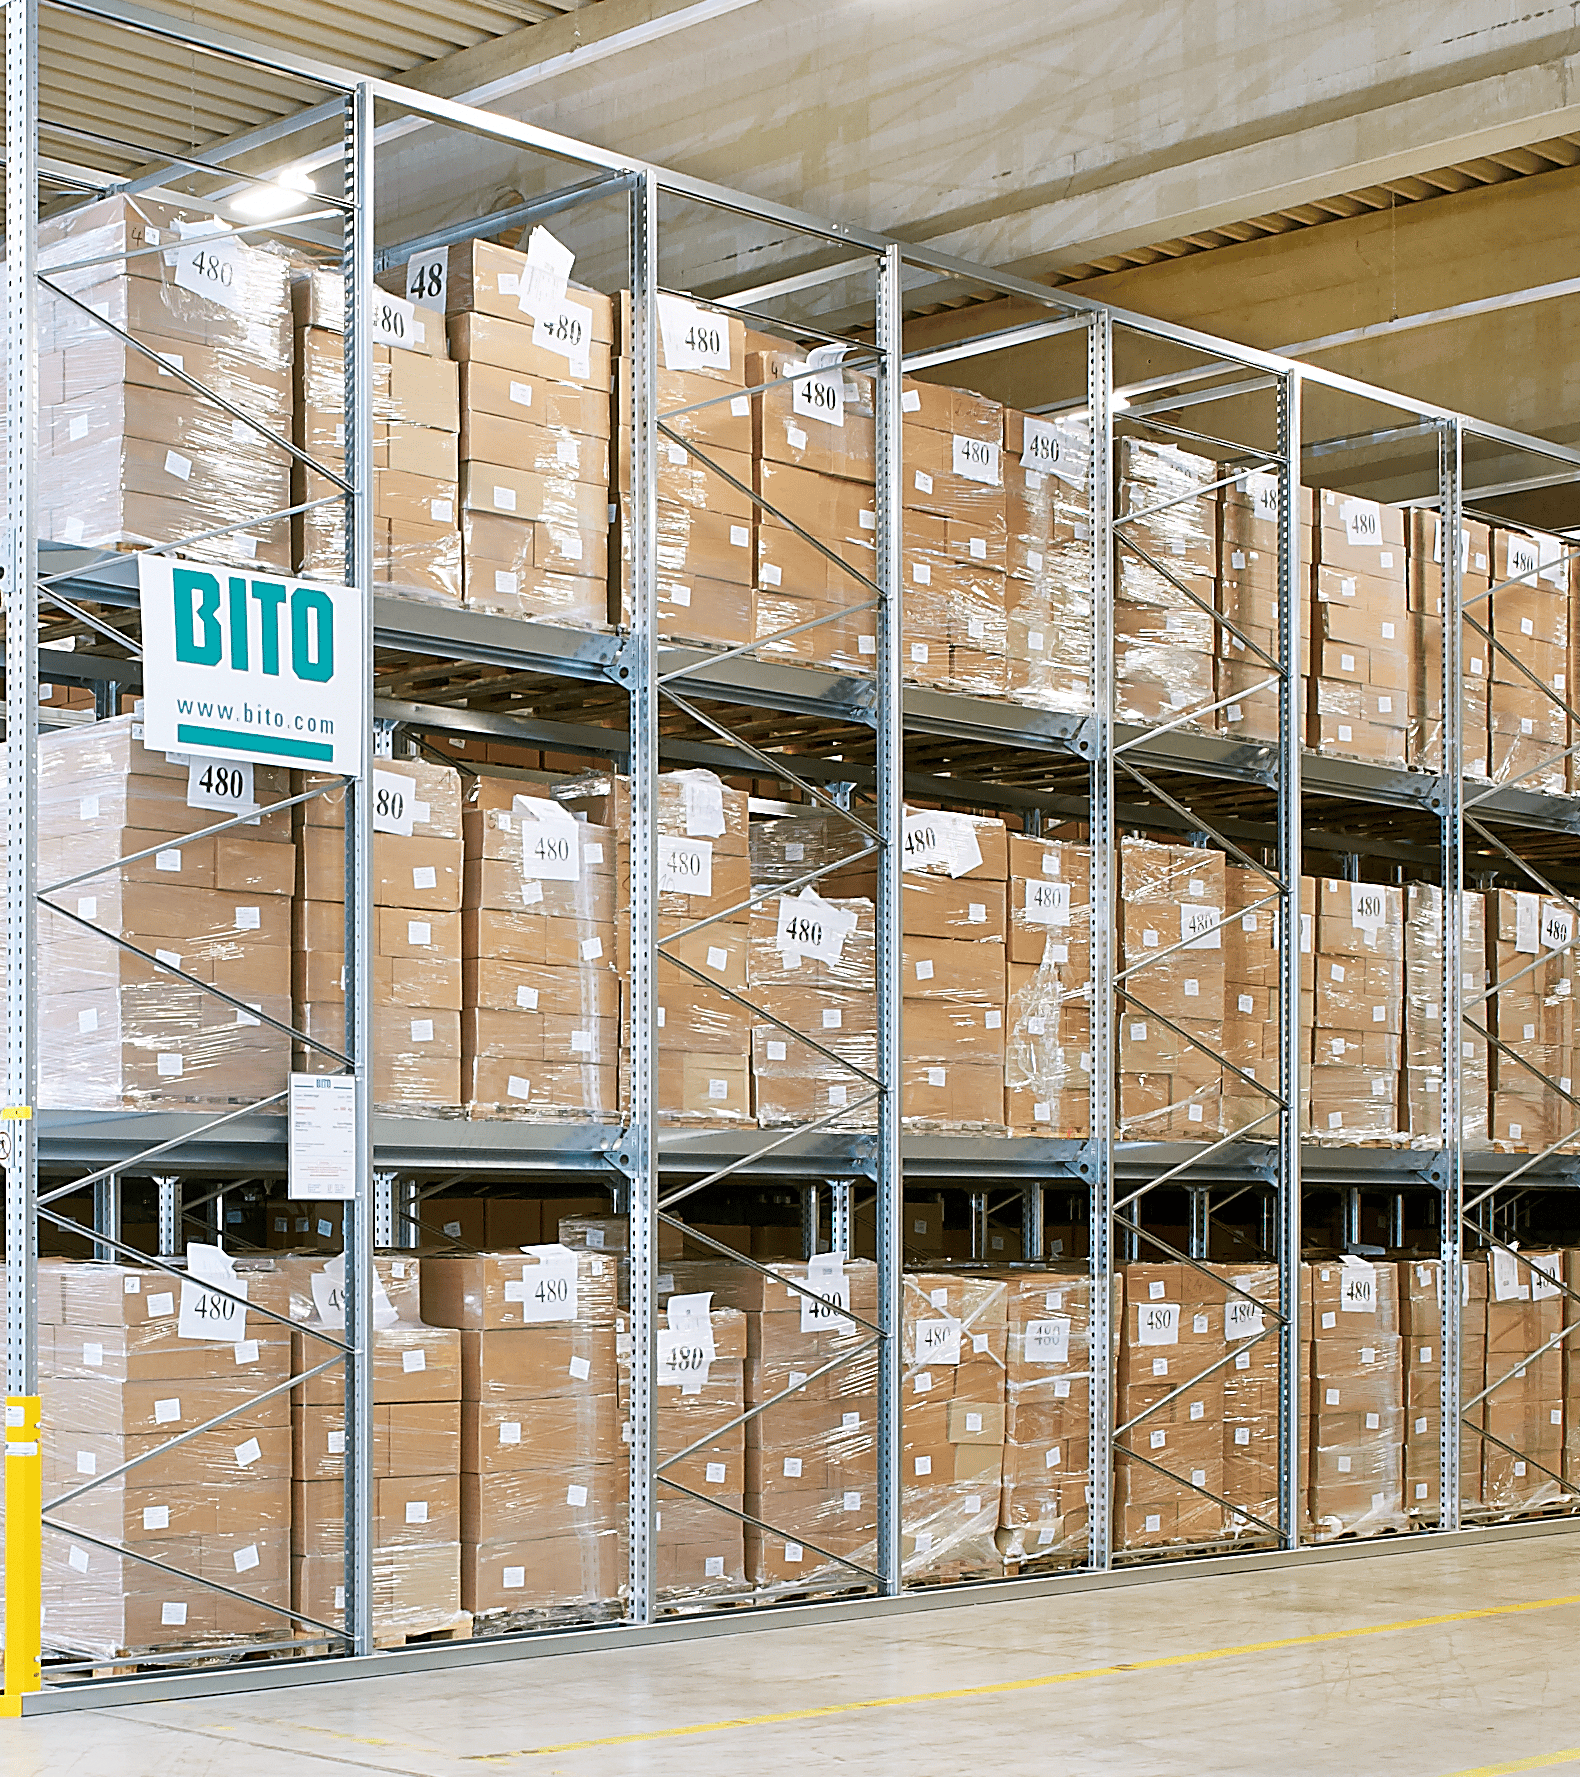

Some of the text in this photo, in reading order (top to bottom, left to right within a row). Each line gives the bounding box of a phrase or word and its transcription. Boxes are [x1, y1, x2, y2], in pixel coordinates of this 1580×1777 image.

[192, 250, 233, 287] 480
[410, 262, 443, 299] 48
[684, 326, 720, 354] 480
[801, 380, 836, 410] 480
[961, 440, 990, 465] 480
[1030, 434, 1060, 462] 480
[1352, 514, 1376, 534] 480
[1512, 550, 1534, 572] 480
[173, 568, 334, 683] BITO
[177, 699, 334, 735] www.bito.com
[198, 765, 243, 798] 480
[372, 789, 403, 819] 80
[534, 836, 569, 861] 480
[904, 827, 937, 855] 480
[667, 852, 701, 876] 480
[1034, 887, 1061, 908] 480
[1357, 896, 1381, 917] 480
[786, 917, 822, 946] 480
[1188, 915, 1213, 933] 480
[1547, 919, 1567, 942] 480
[534, 1279, 568, 1303] 480
[1346, 1281, 1370, 1302] 480
[195, 1294, 235, 1321] 480
[808, 1292, 842, 1318] 480
[1231, 1303, 1256, 1324] 480
[1146, 1310, 1171, 1330] 480
[925, 1327, 950, 1347] 480
[1035, 1326, 1060, 1345] 480
[666, 1346, 703, 1370] 480
